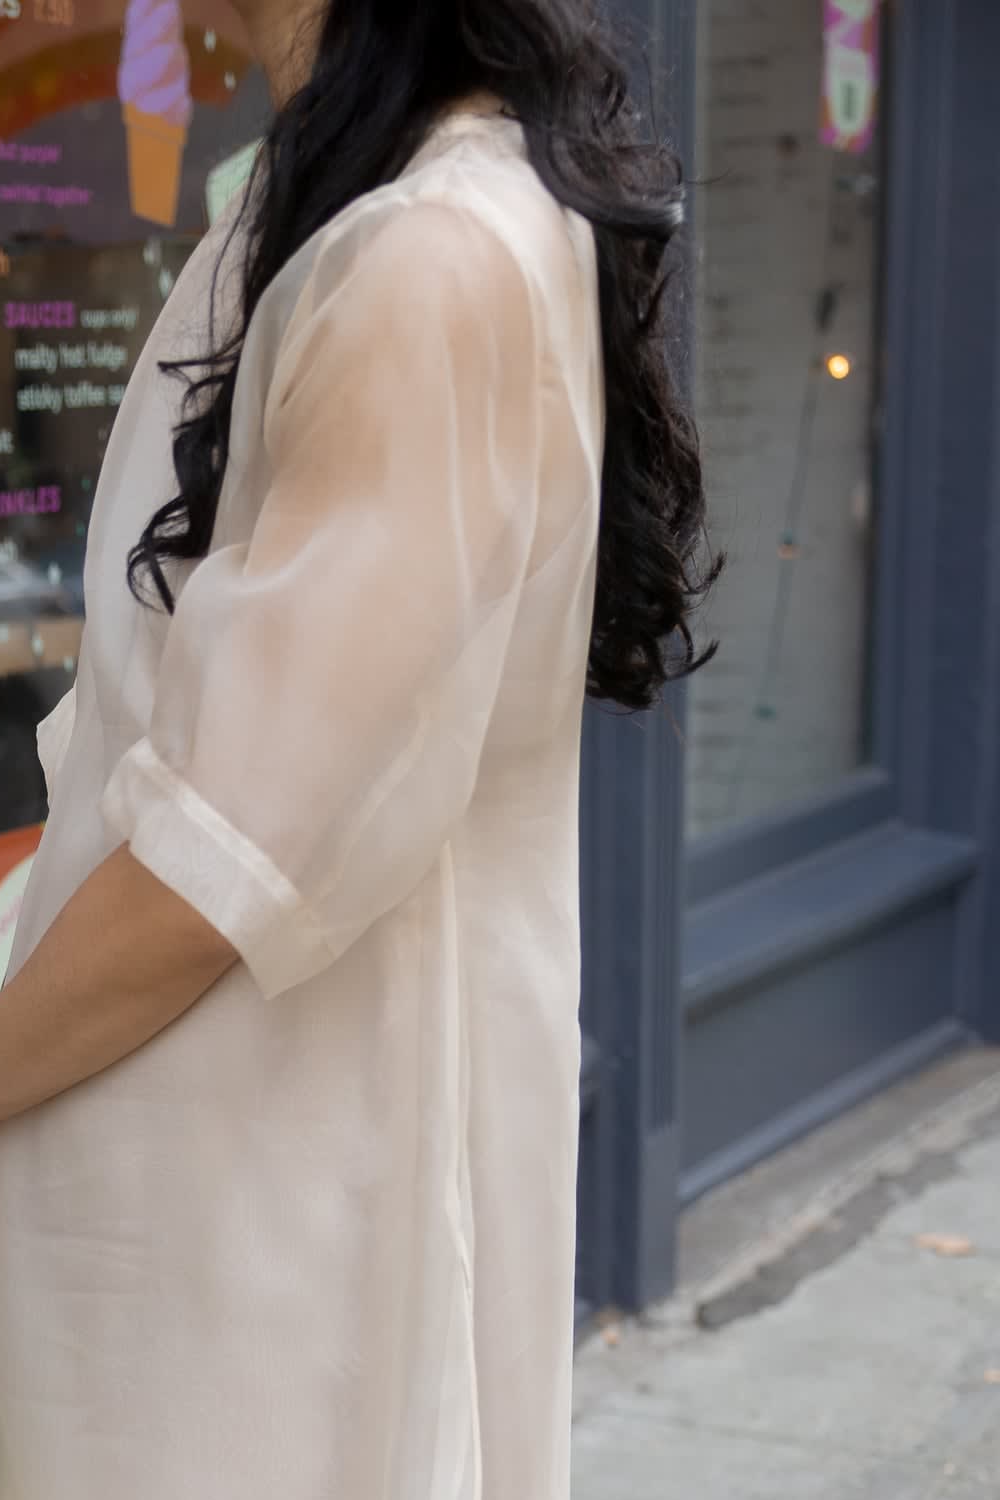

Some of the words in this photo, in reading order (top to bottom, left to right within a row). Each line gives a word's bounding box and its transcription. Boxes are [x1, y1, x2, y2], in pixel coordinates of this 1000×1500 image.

[4, 302, 75, 329] SAUCES
[58, 341, 87, 368] hot
[87, 340, 127, 372] fudge
